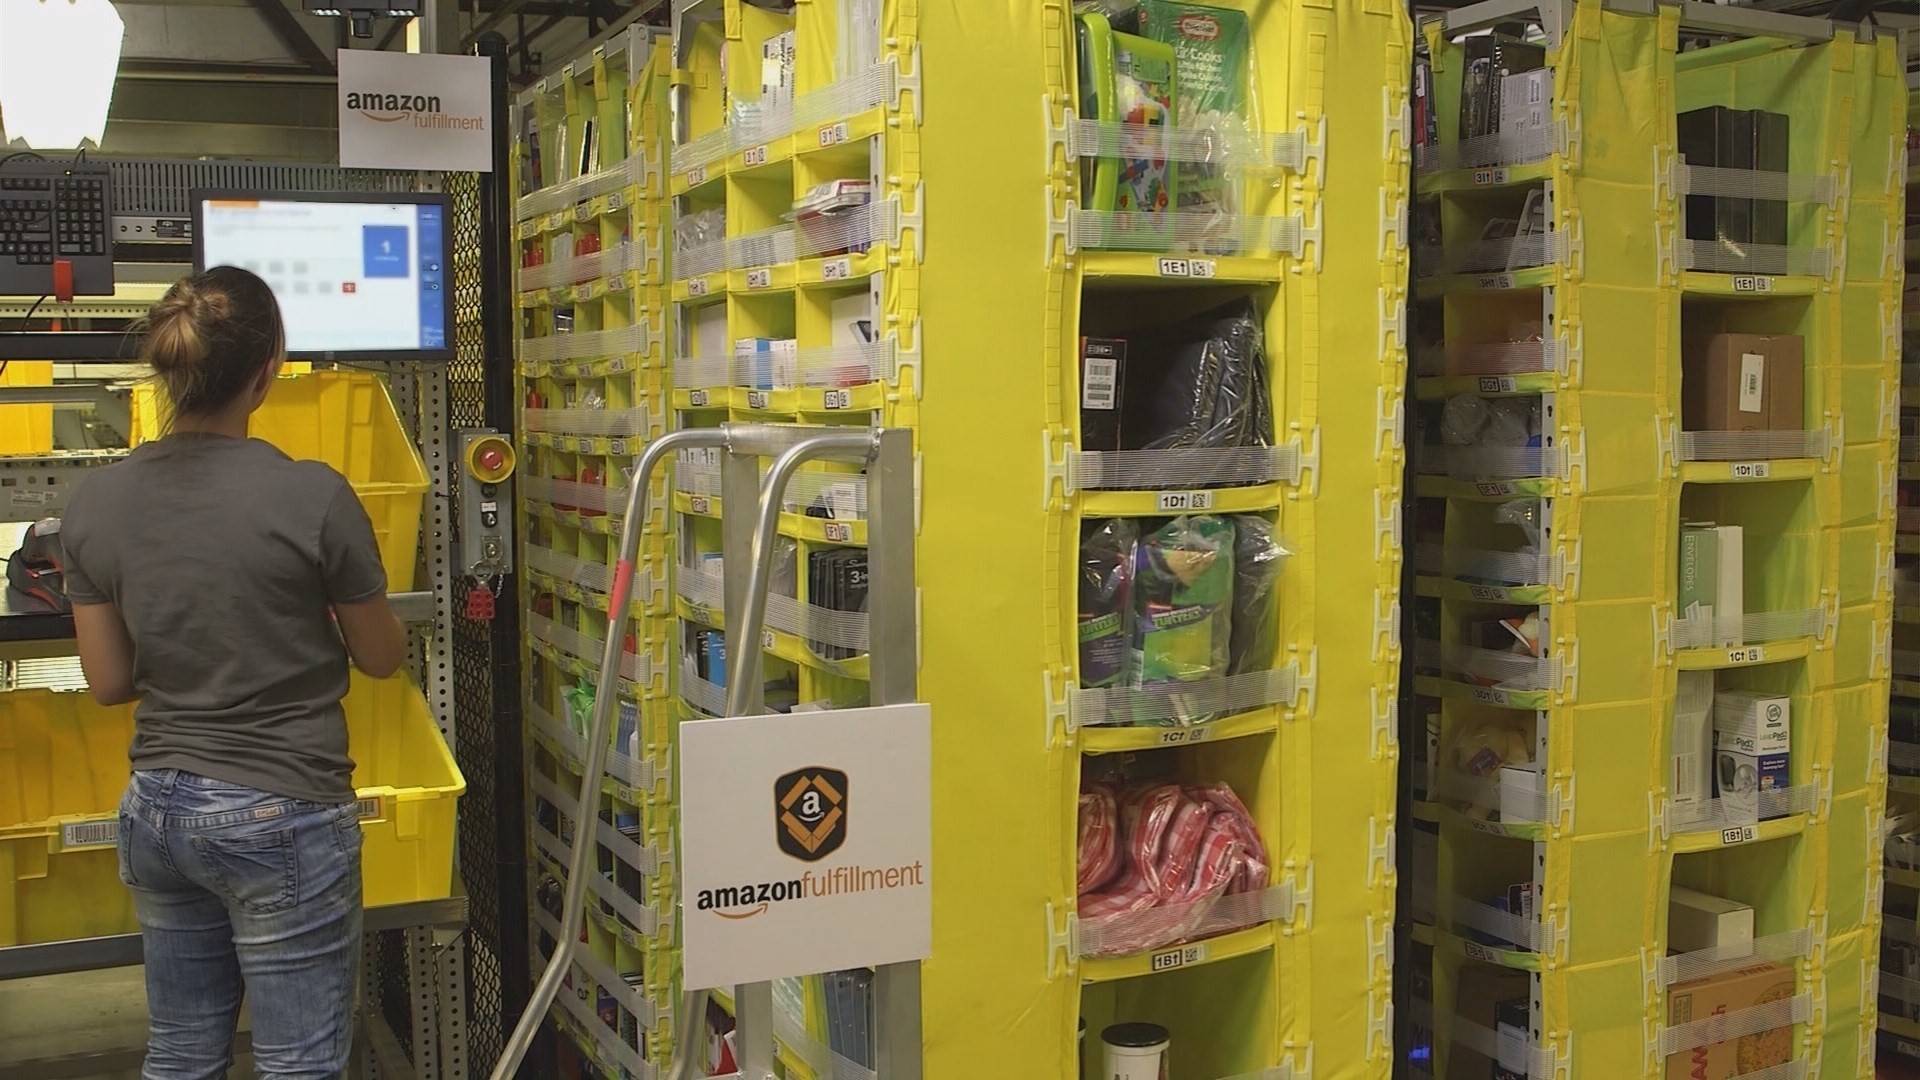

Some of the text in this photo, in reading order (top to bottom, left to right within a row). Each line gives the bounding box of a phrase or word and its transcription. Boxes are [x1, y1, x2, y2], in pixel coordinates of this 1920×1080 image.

[347, 90, 441, 113] amazon
[413, 112, 484, 131] fulfillment
[1163, 262, 1179, 273] 1E
[1737, 280, 1748, 289] 1E
[1736, 466, 1746, 475] 1D
[1163, 496, 1179, 507] 1D
[1684, 535, 1695, 592] ENVELOPES
[1080, 616, 1120, 634] URTLES
[1729, 652, 1741, 662] 1C
[1163, 732, 1179, 742] 1C
[1725, 832, 1736, 841] 1B
[1157, 955, 1173, 967] 1B
